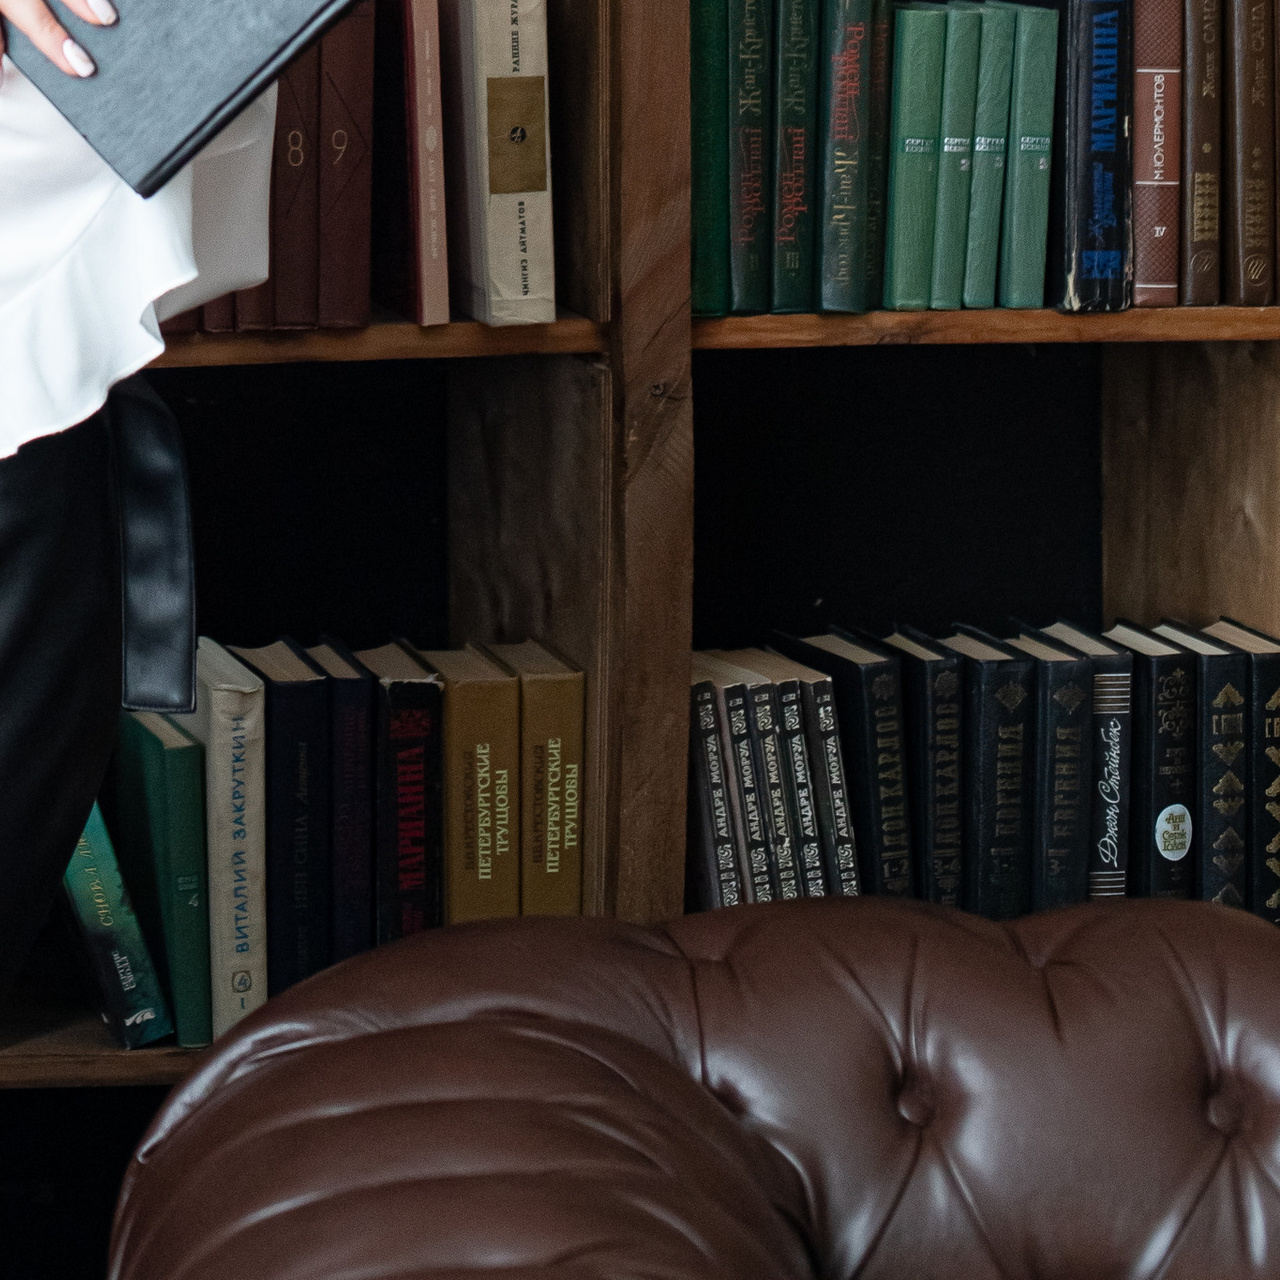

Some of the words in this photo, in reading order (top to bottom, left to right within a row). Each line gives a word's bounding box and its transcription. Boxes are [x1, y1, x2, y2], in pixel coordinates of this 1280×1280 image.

[510, 29, 521, 73] РАННИЕ
[1090, 10, 1119, 153] МАРИАННА
[287, 130, 305, 167] 8
[332, 129, 348, 165] 9
[517, 199, 528, 254] АЙТМАТОВ
[520, 257, 530, 296] ЧИНГИЗ
[705, 734, 722, 784] МОРУА
[737, 738, 754, 788] МОРУА
[764, 735, 781, 784] МОРУА
[790, 734, 807, 784] МОРУА
[825, 735, 843, 785] МОРУА
[877, 706, 904, 799] КАРЛОС
[1097, 717, 1121, 804] Стейнбек
[231, 717, 249, 841] ЗАКРУТКИН
[397, 745, 427, 892] МАРИАННА
[476, 743, 493, 881] ПЕТЕРБУРГСКИЕ
[495, 768, 510, 855] ТРУЩОБЫ
[545, 738, 562, 874] ПЕТЕРБУРГСКИЕ
[563, 763, 579, 850] ТРУЩОБЫ
[712, 788, 730, 838] АНДРЕ
[743, 790, 762, 841] АНДРЕ
[770, 787, 787, 837] АНДРЕ
[797, 787, 815, 837] АНДРЕ
[832, 788, 851, 838] АНДРЕ
[1096, 803, 1120, 868] Джон
[83, 866, 115, 928] СНОВА
[230, 849, 251, 953] ВИТАЛИЙ
